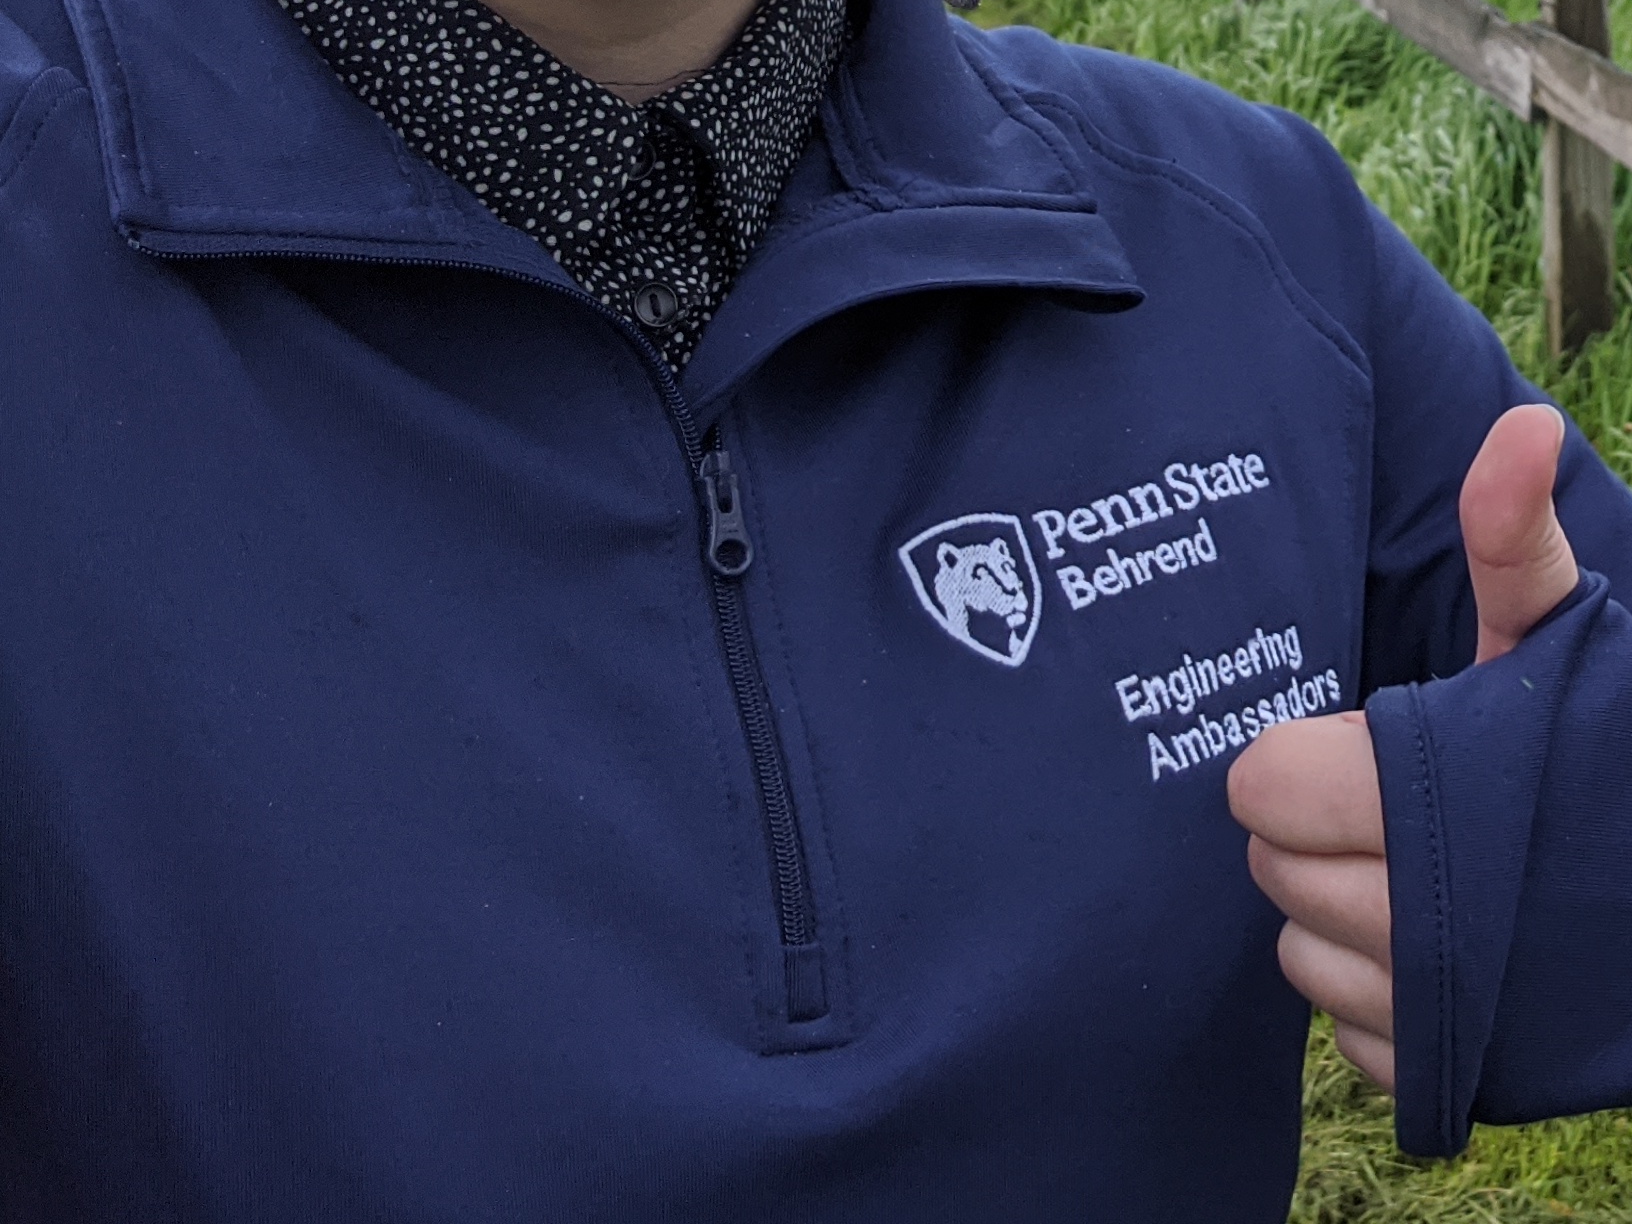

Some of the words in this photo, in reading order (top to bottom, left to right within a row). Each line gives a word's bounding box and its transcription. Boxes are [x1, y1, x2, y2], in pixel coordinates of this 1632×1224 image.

[1057, 517, 1217, 610] Behrend
[1115, 625, 1303, 722] Engineering
[1147, 668, 1341, 781] Ambassadors
